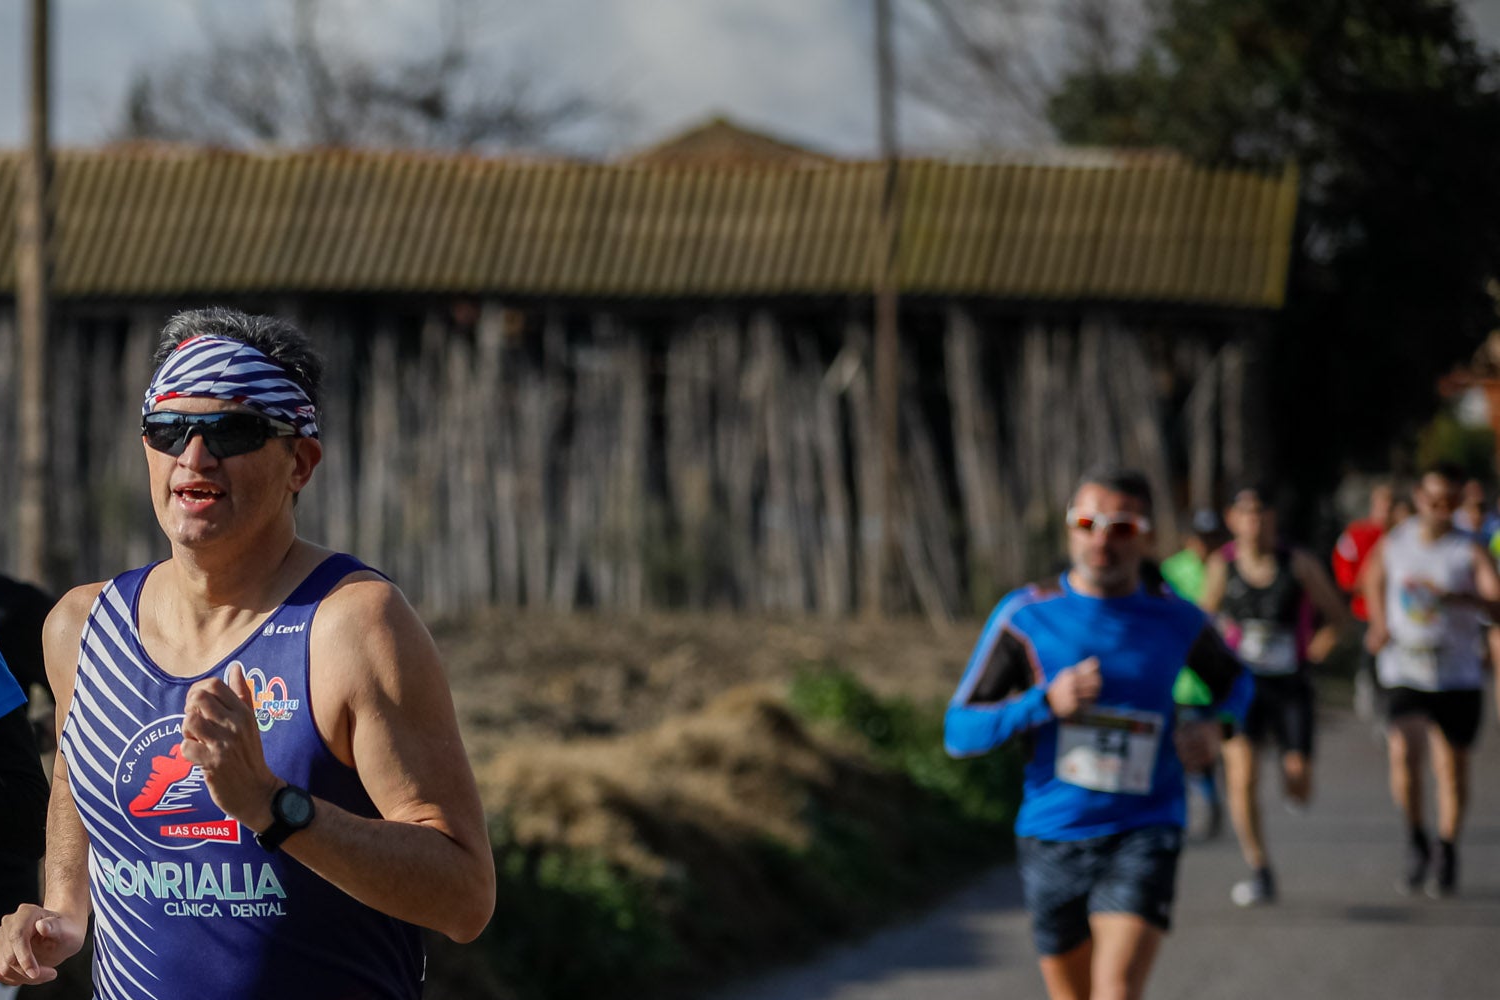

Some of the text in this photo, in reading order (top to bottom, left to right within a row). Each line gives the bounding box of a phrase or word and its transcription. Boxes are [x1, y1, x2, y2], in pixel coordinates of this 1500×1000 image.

[121, 723, 182, 784] C.A. HUELLA
[168, 825, 230, 837] LAS GABIAS
[99, 857, 287, 901] SONRIALIA
[164, 900, 287, 918] CLÍNICA DENTAL
